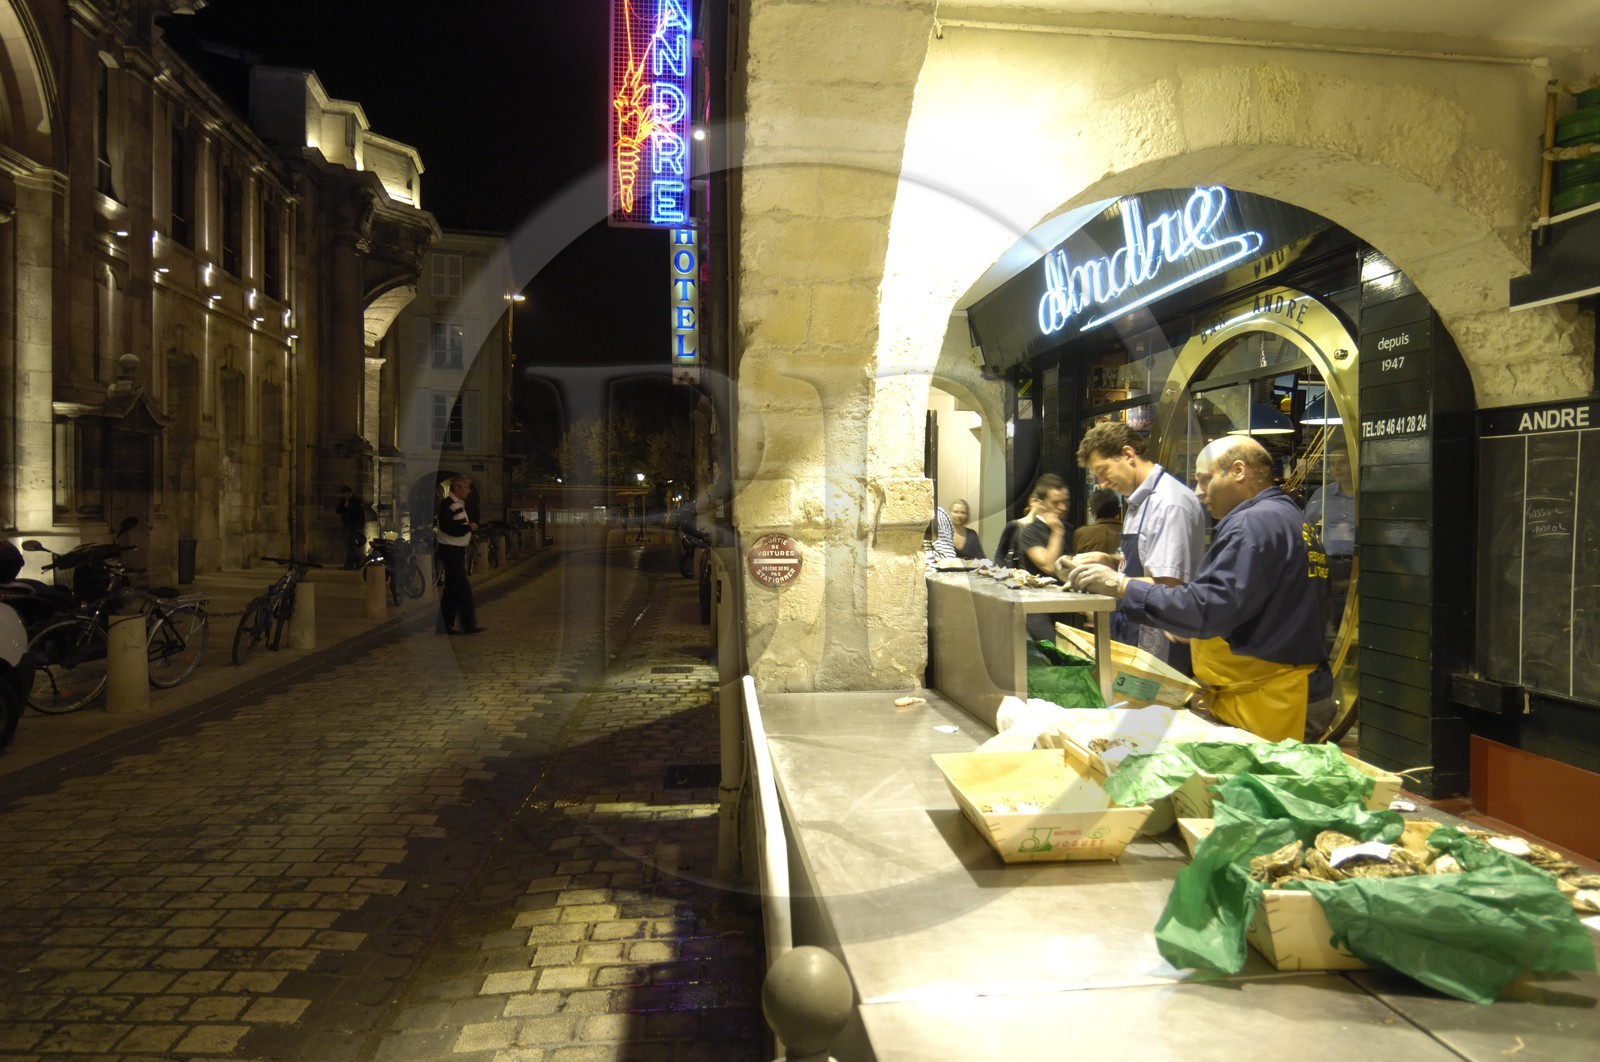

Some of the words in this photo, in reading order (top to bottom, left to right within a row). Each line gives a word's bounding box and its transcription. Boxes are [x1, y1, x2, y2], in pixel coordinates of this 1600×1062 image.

[651, 0, 691, 223] ANDRE
[674, 229, 696, 358] HOTEL
[1253, 294, 1309, 325] ANDRE
[1377, 332, 1409, 351] depuis
[1381, 356, 1405, 371] 1947
[1386, 418, 1396, 435] 46
[1396, 416, 1405, 434] 41
[1406, 415, 1416, 433] 28
[1416, 413, 1427, 432] 24
[1518, 406, 1590, 432] ANDRE
[756, 567, 796, 583] STATIONNER
[1116, 676, 1126, 687] 3
